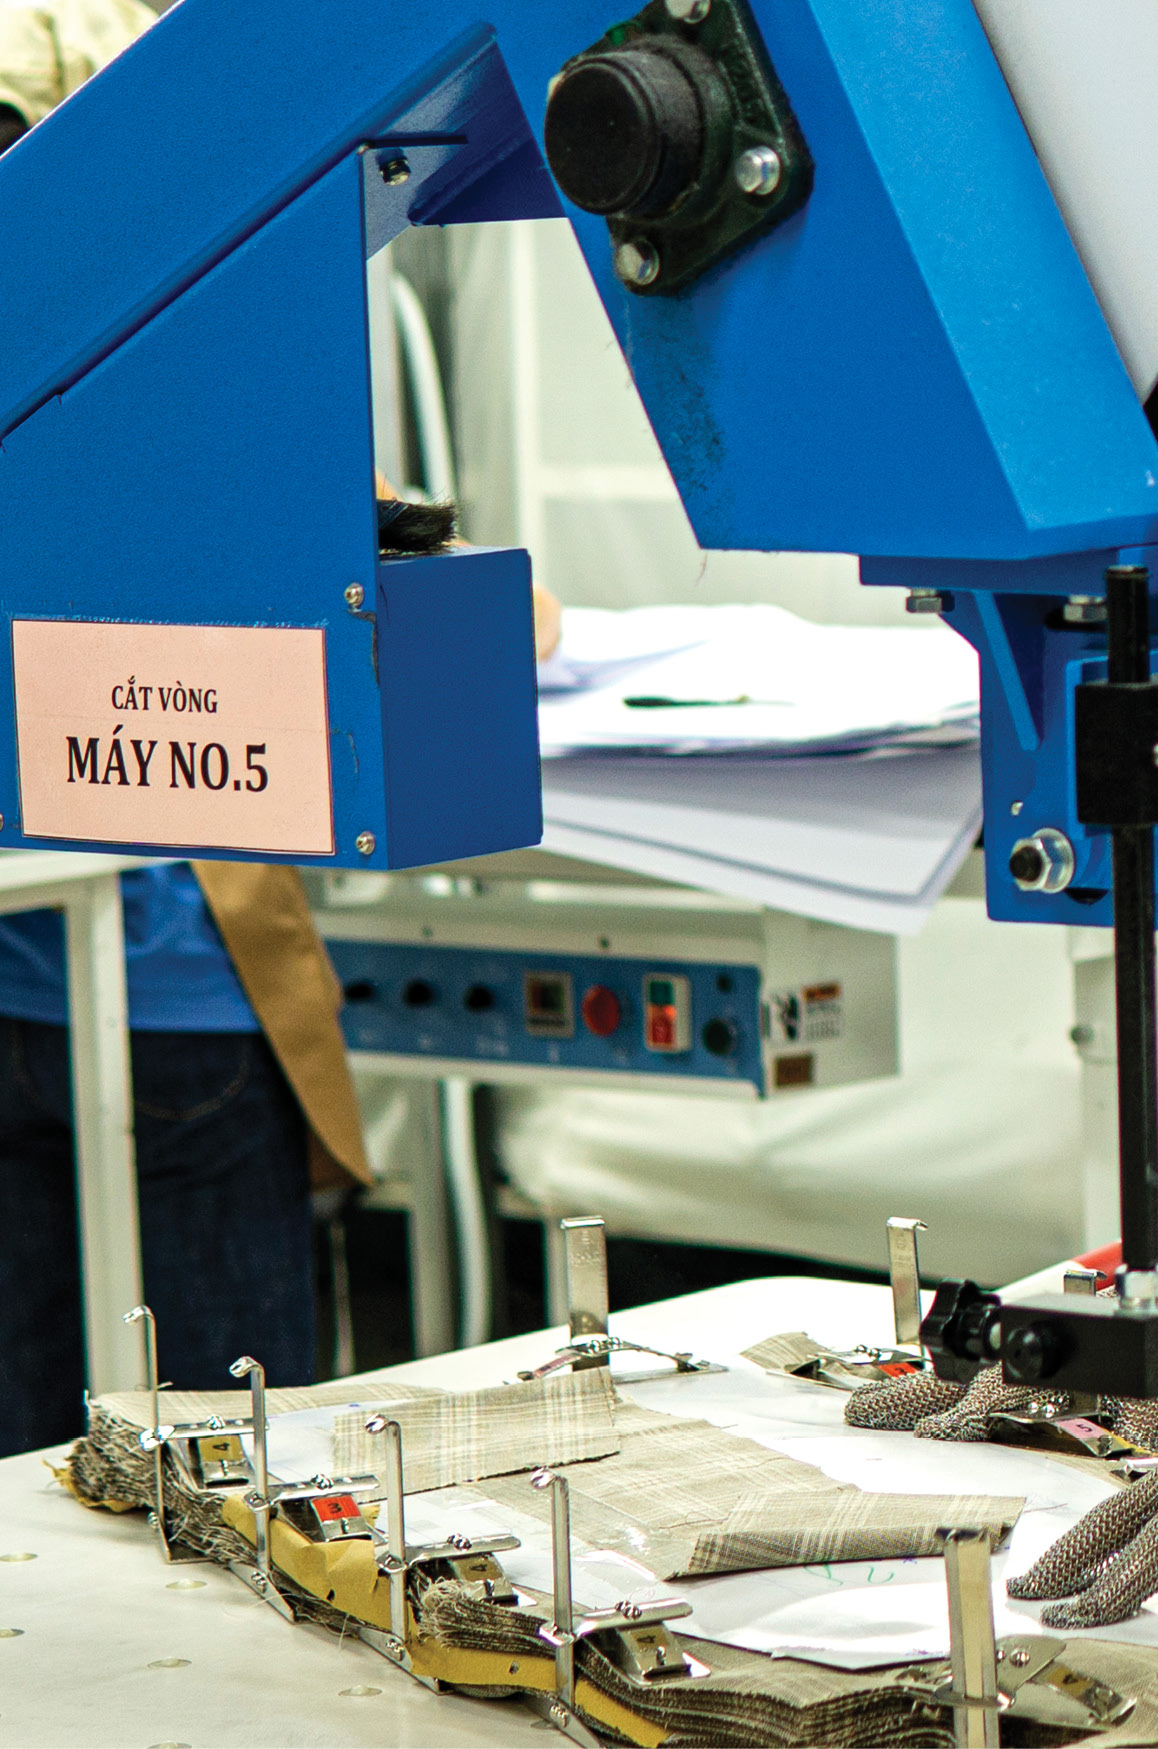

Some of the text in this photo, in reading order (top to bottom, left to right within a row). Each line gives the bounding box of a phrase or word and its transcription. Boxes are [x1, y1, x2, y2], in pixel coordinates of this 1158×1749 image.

[112, 675, 218, 714] CẮT VÒNG
[66, 724, 269, 793] MÁY NO.5
